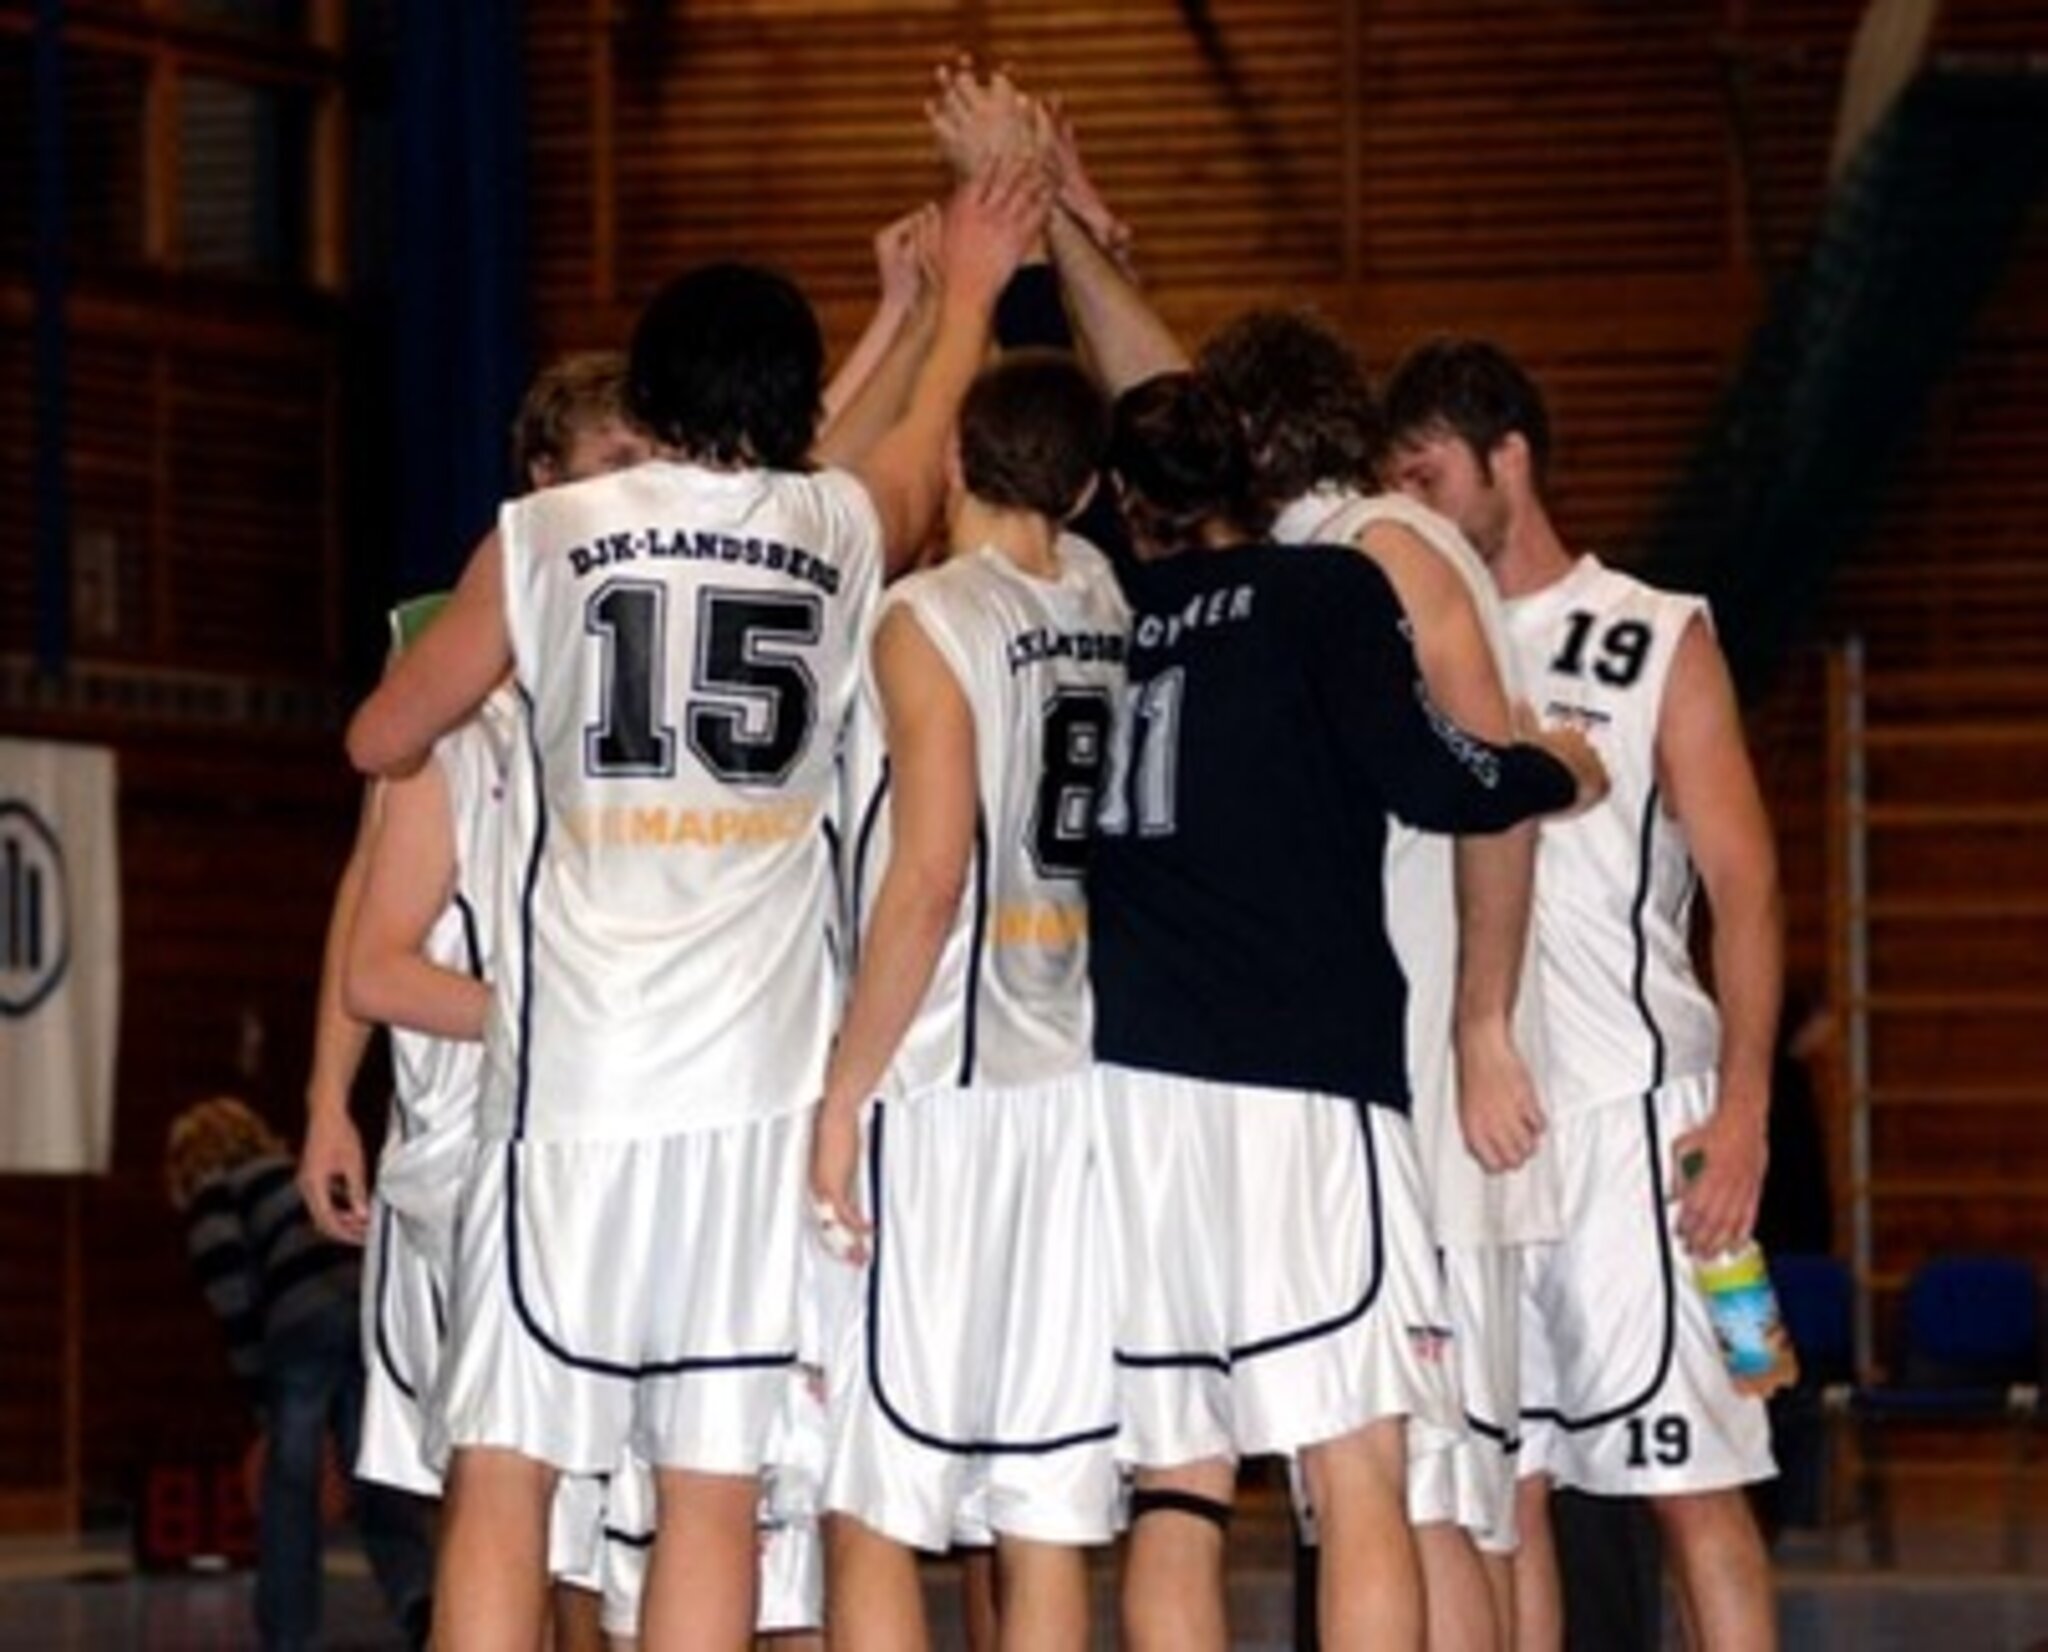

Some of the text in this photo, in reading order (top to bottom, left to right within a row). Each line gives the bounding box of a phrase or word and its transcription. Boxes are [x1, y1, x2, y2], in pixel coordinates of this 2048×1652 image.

[585, 577, 824, 789] 15
[1549, 610, 1654, 690] 19
[1022, 684, 1116, 880] 8
[1626, 1415, 1690, 1469] 19
